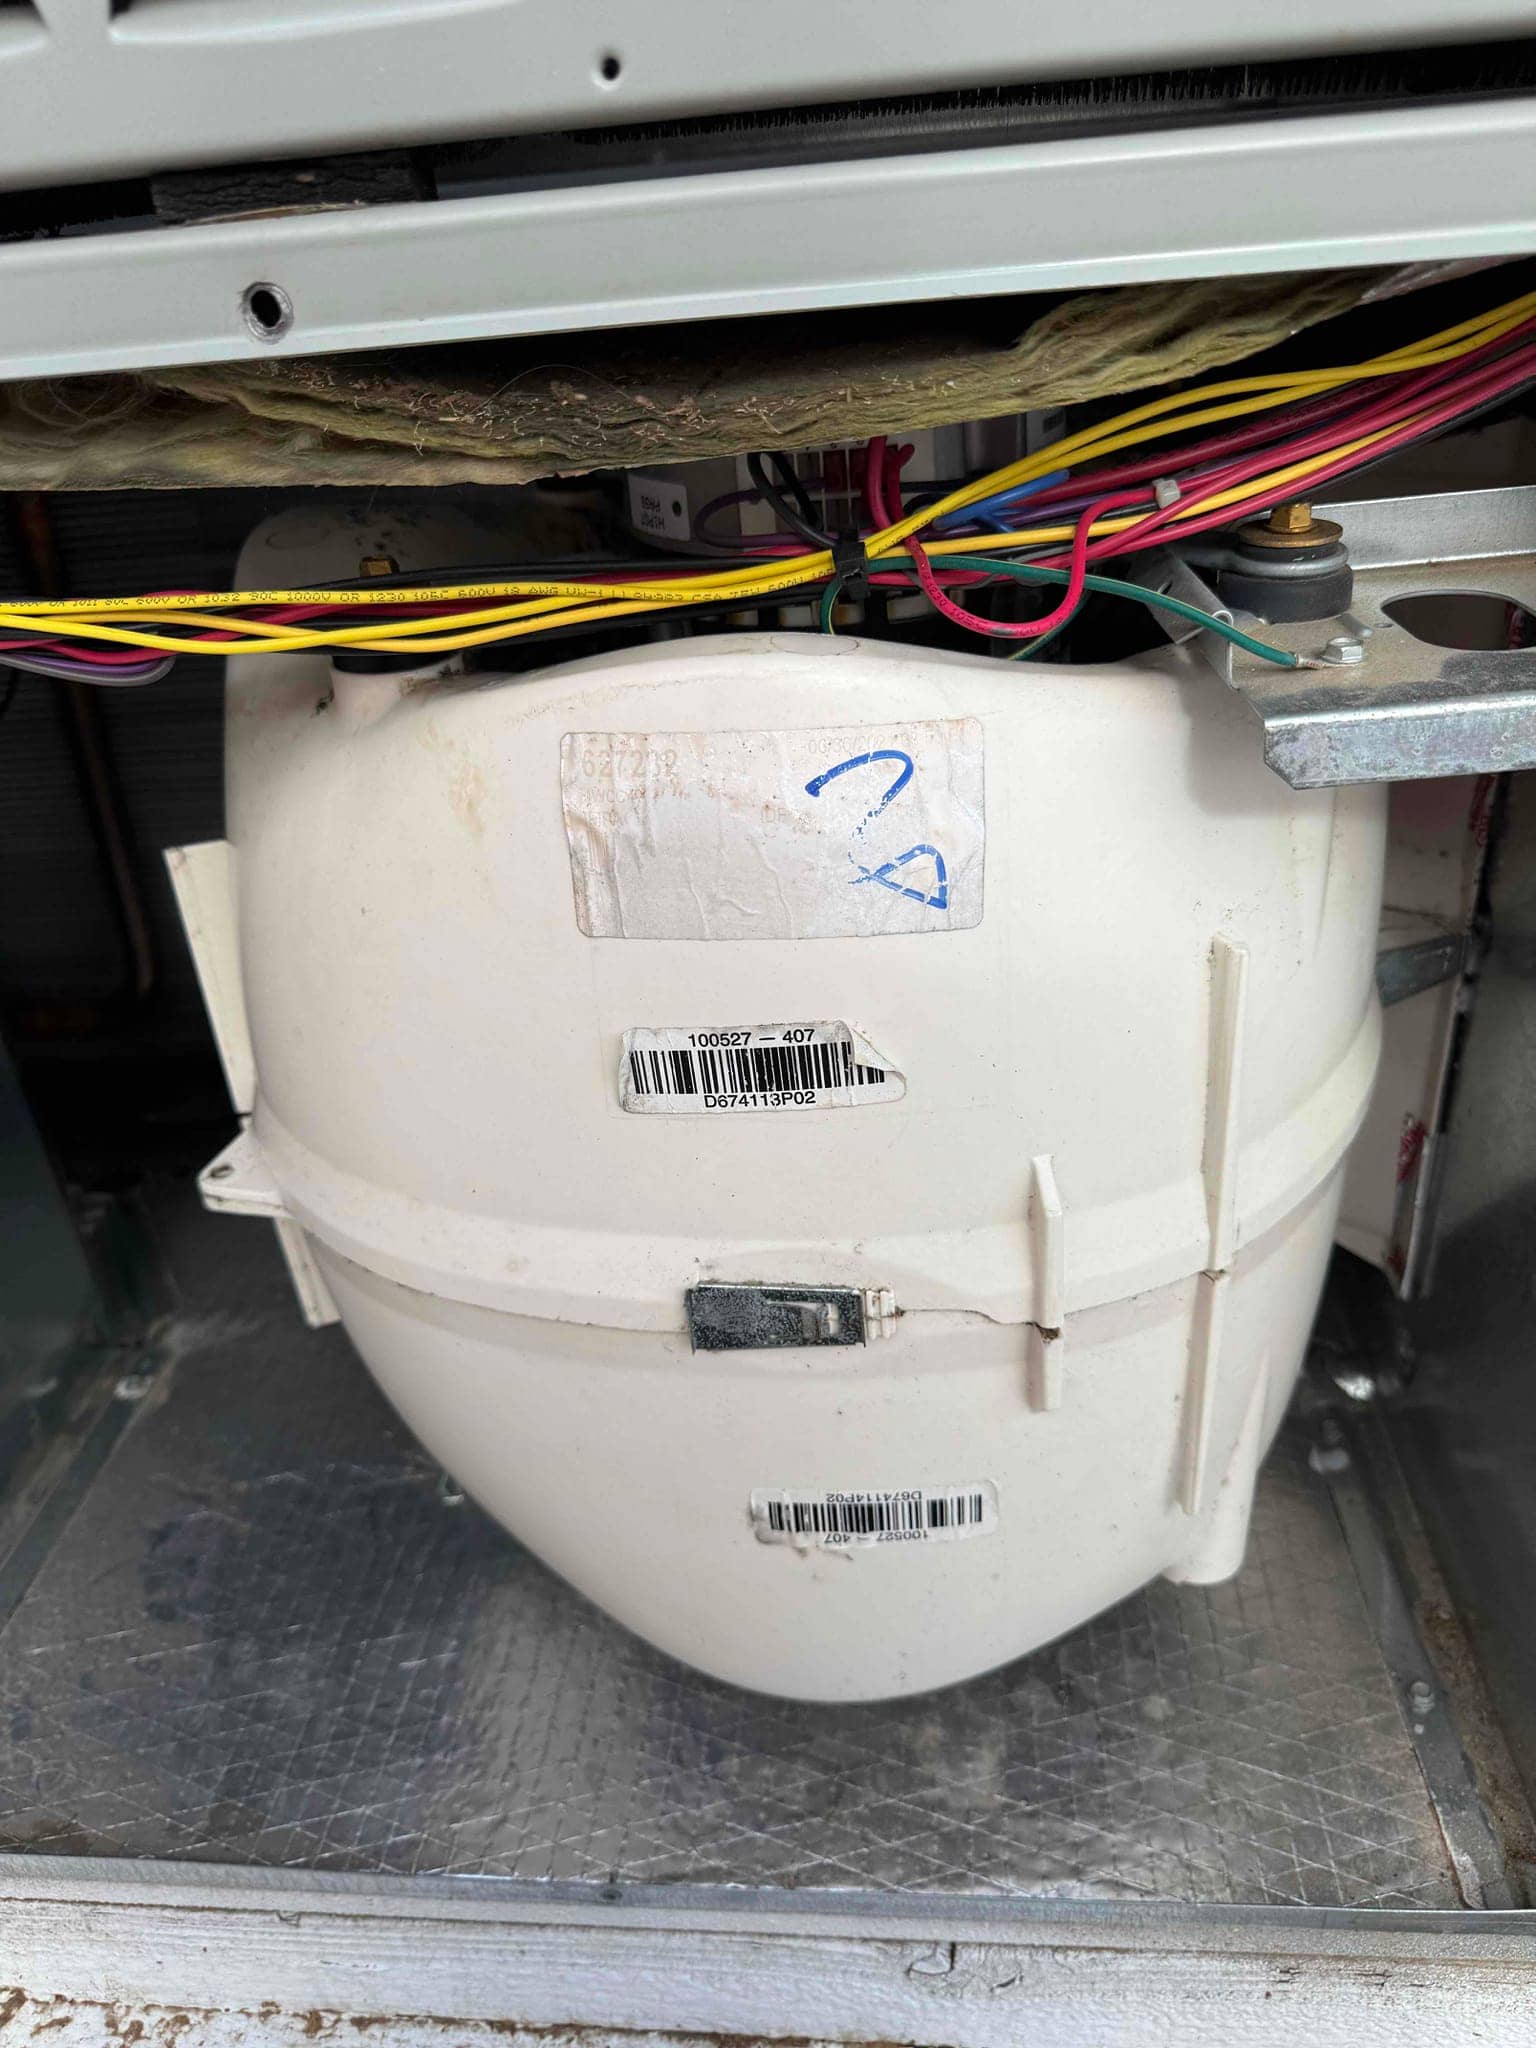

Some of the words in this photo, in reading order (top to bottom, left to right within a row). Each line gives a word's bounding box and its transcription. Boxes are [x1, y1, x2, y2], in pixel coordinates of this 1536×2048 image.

[287, 591, 331, 602] 1000V
[340, 592, 360, 603] OR
[369, 592, 406, 603] 1230
[457, 586, 495, 597] 600V
[688, 1031, 752, 1048] 100527
[782, 1029, 815, 1043] 407
[704, 1090, 816, 1108] D674113P02
[826, 1490, 922, 1503] D674114P02
[824, 1533, 851, 1544] 407
[876, 1531, 928, 1543] 100527
